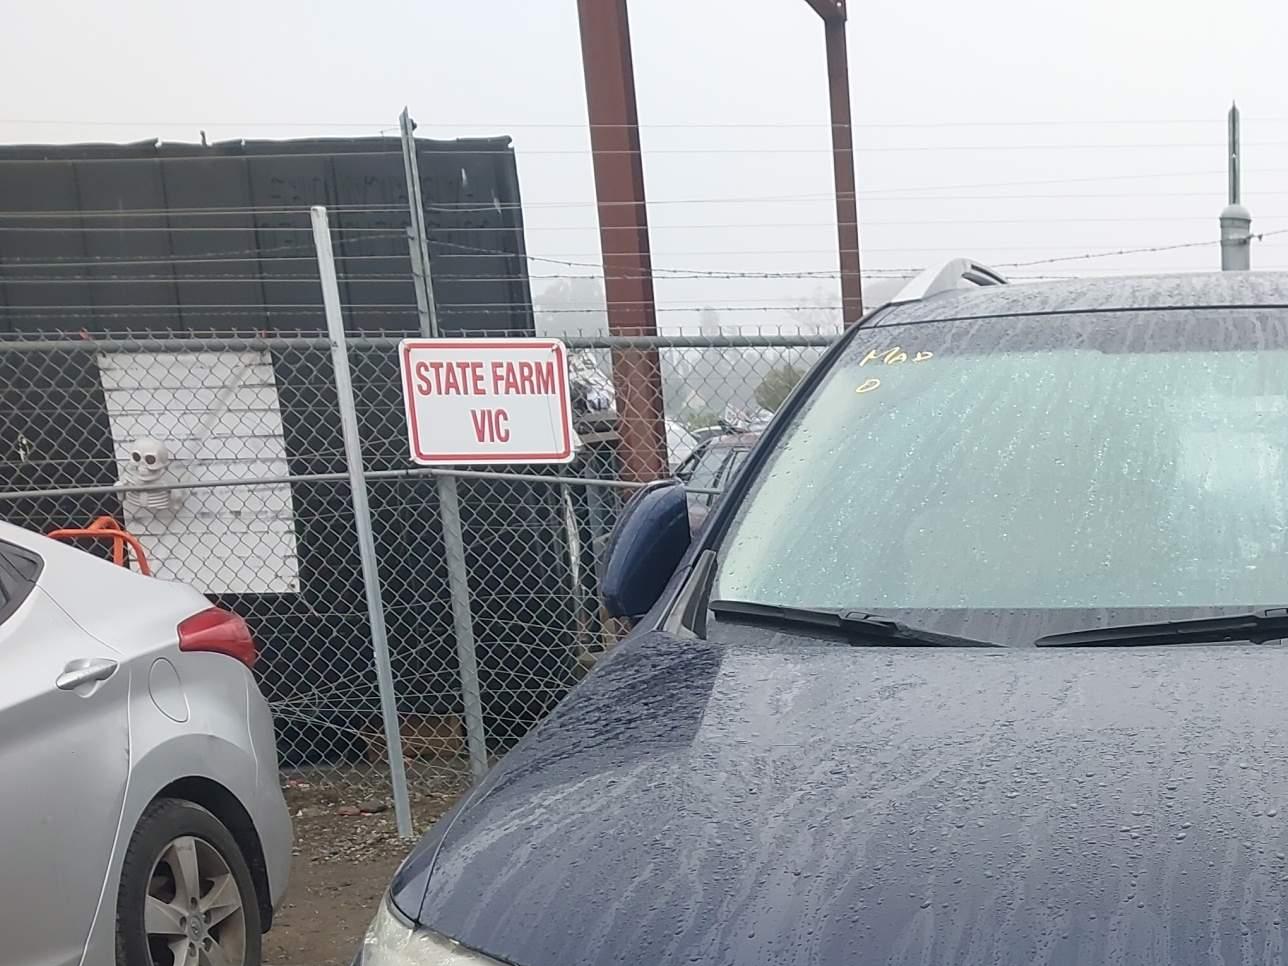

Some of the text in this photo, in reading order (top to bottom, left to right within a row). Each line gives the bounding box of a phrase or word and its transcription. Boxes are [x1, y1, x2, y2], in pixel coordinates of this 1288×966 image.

[415, 361, 556, 396] STATE FARM
[470, 408, 511, 443] VIC
